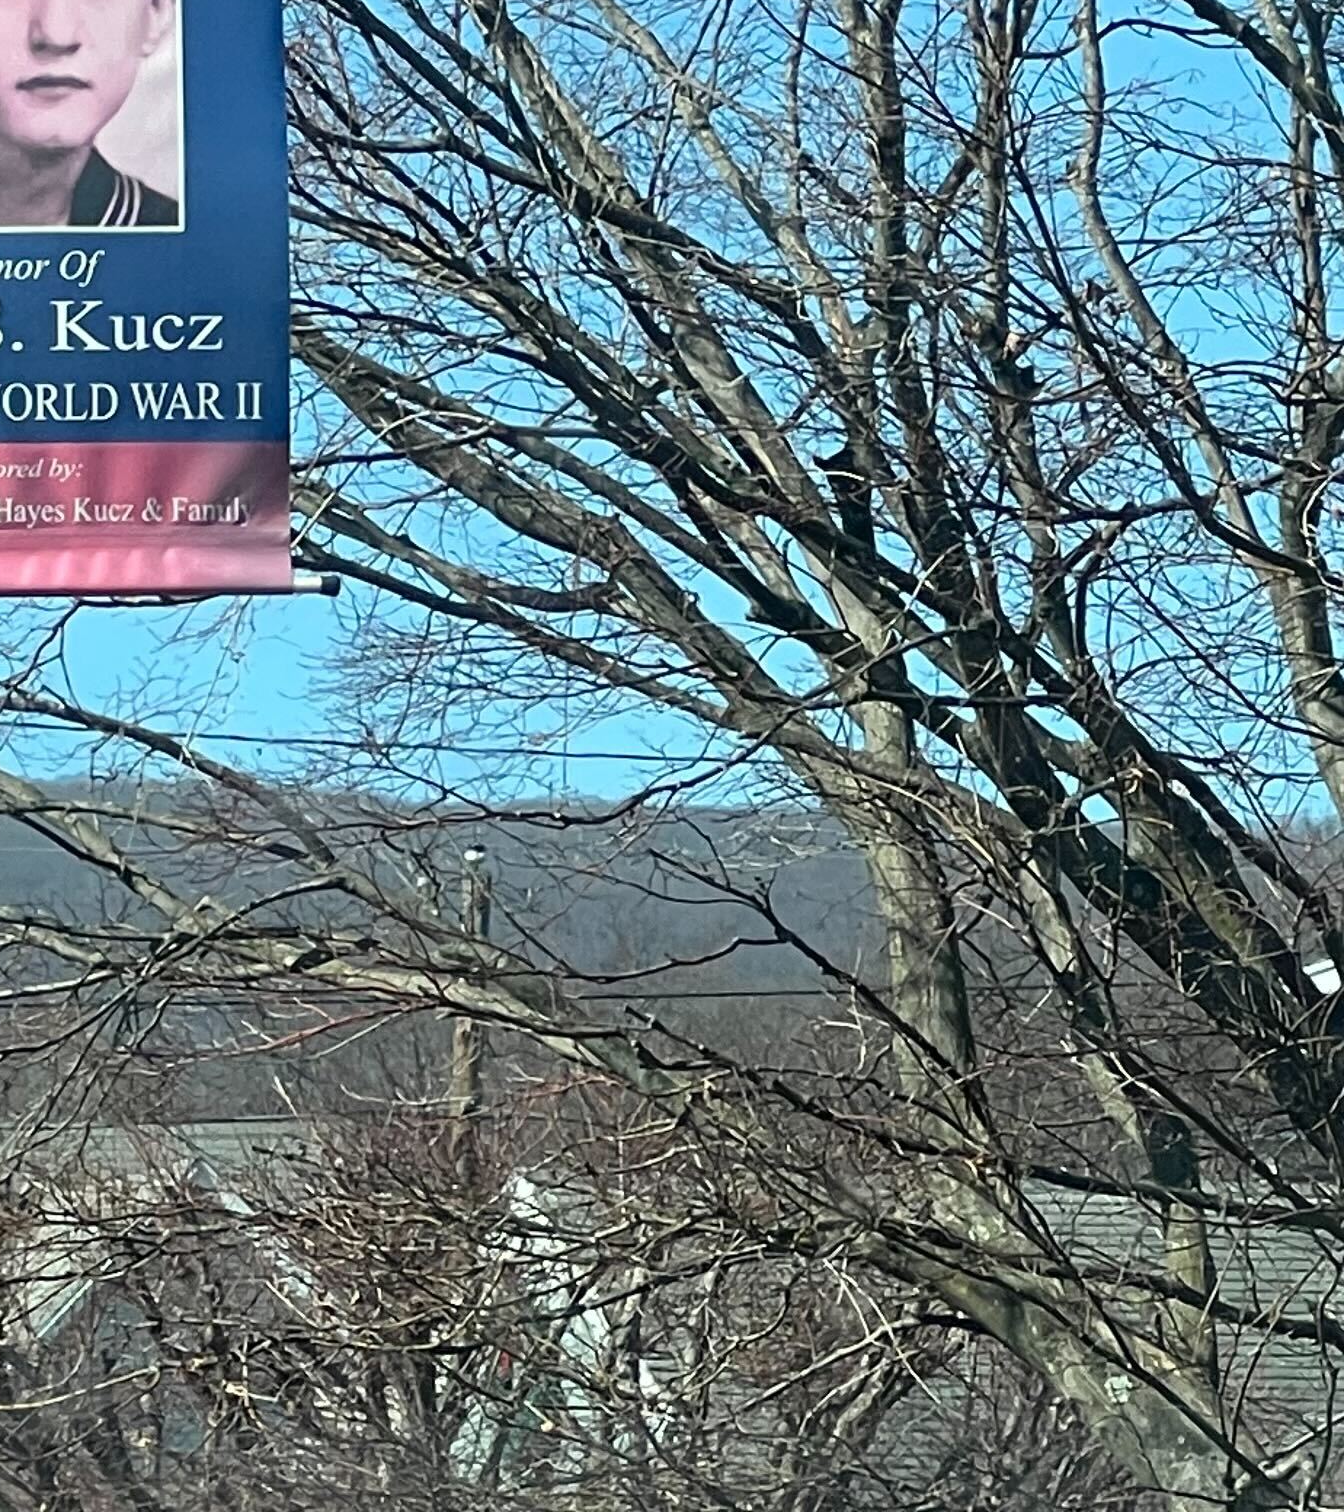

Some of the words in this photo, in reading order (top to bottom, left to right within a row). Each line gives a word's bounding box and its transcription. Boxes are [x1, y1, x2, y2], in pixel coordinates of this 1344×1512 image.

[58, 250, 105, 287] Of
[48, 300, 223, 352] Kucz
[131, 383, 222, 420] WAR
[235, 383, 263, 420] II
[49, 458, 83, 481] by:
[73, 497, 134, 522] Kucz
[141, 497, 163, 522] &
